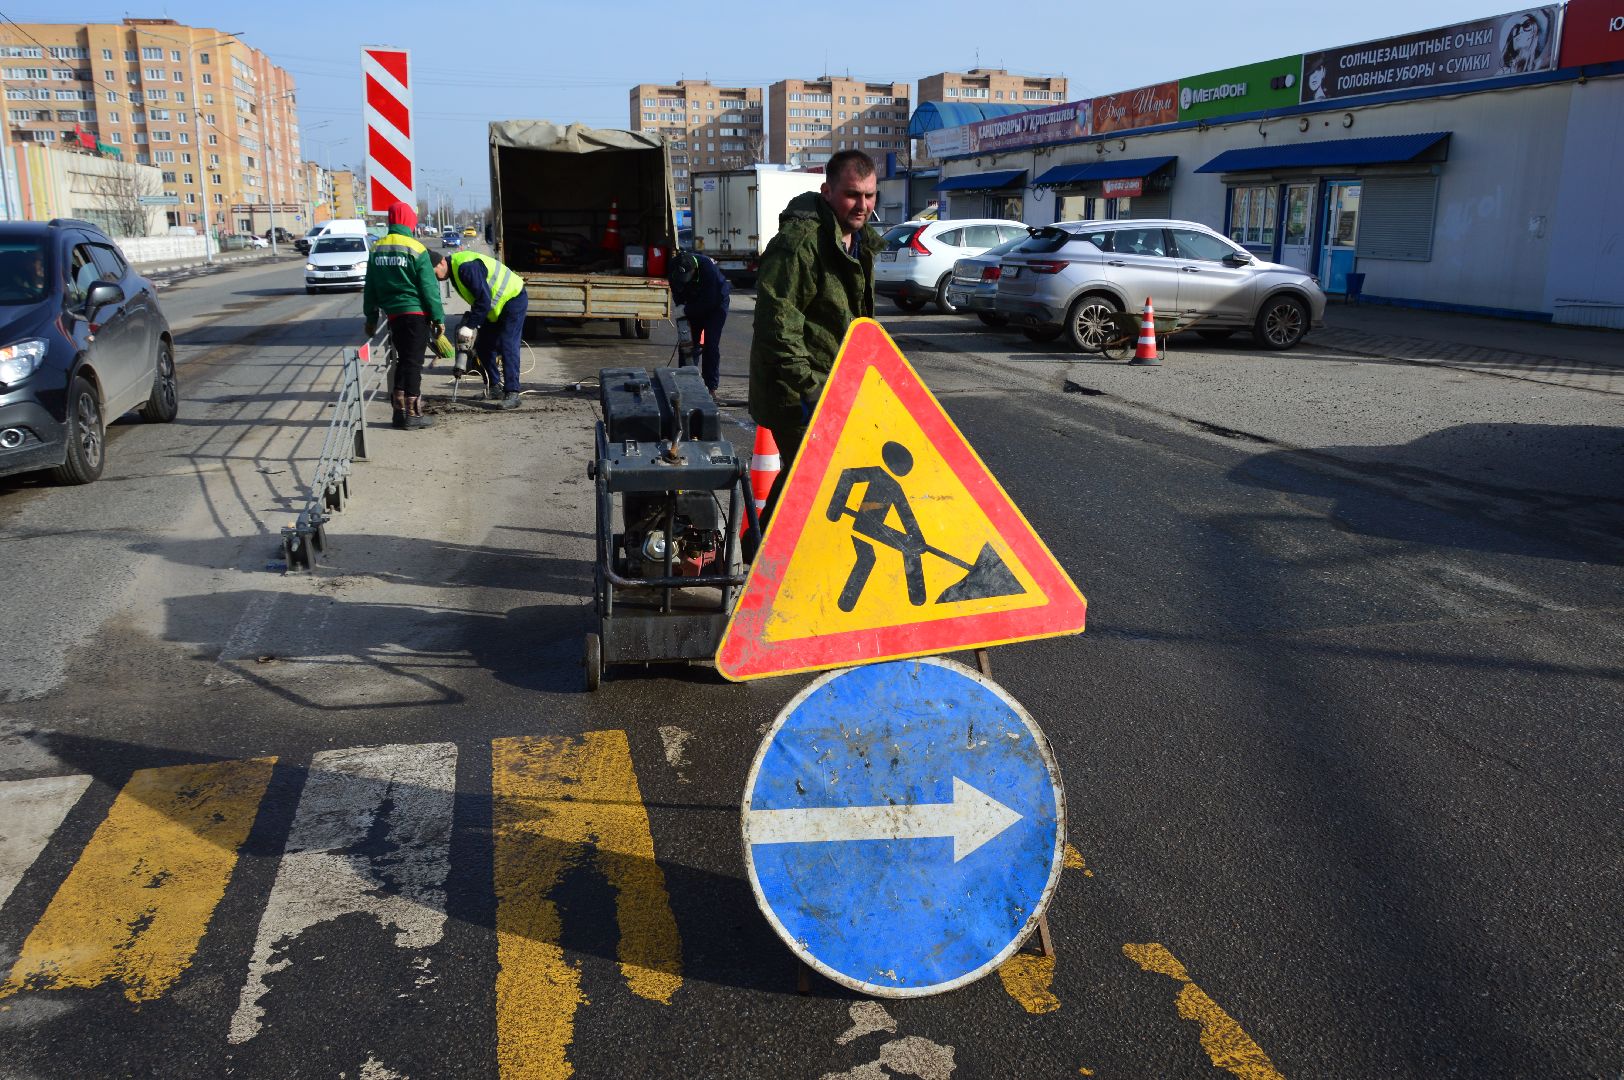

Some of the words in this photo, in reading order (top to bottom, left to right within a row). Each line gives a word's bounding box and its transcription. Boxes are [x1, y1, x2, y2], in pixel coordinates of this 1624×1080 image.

[1339, 36, 1452, 69] СОЛНЦЕЗАЩИТНЫЕ
[1455, 28, 1493, 49] ОЧКИ
[1337, 68, 1394, 90] ГОЛОВНЫЕ
[1395, 62, 1436, 82] УБОРЫ
[1446, 53, 1491, 74] СУМКИ
